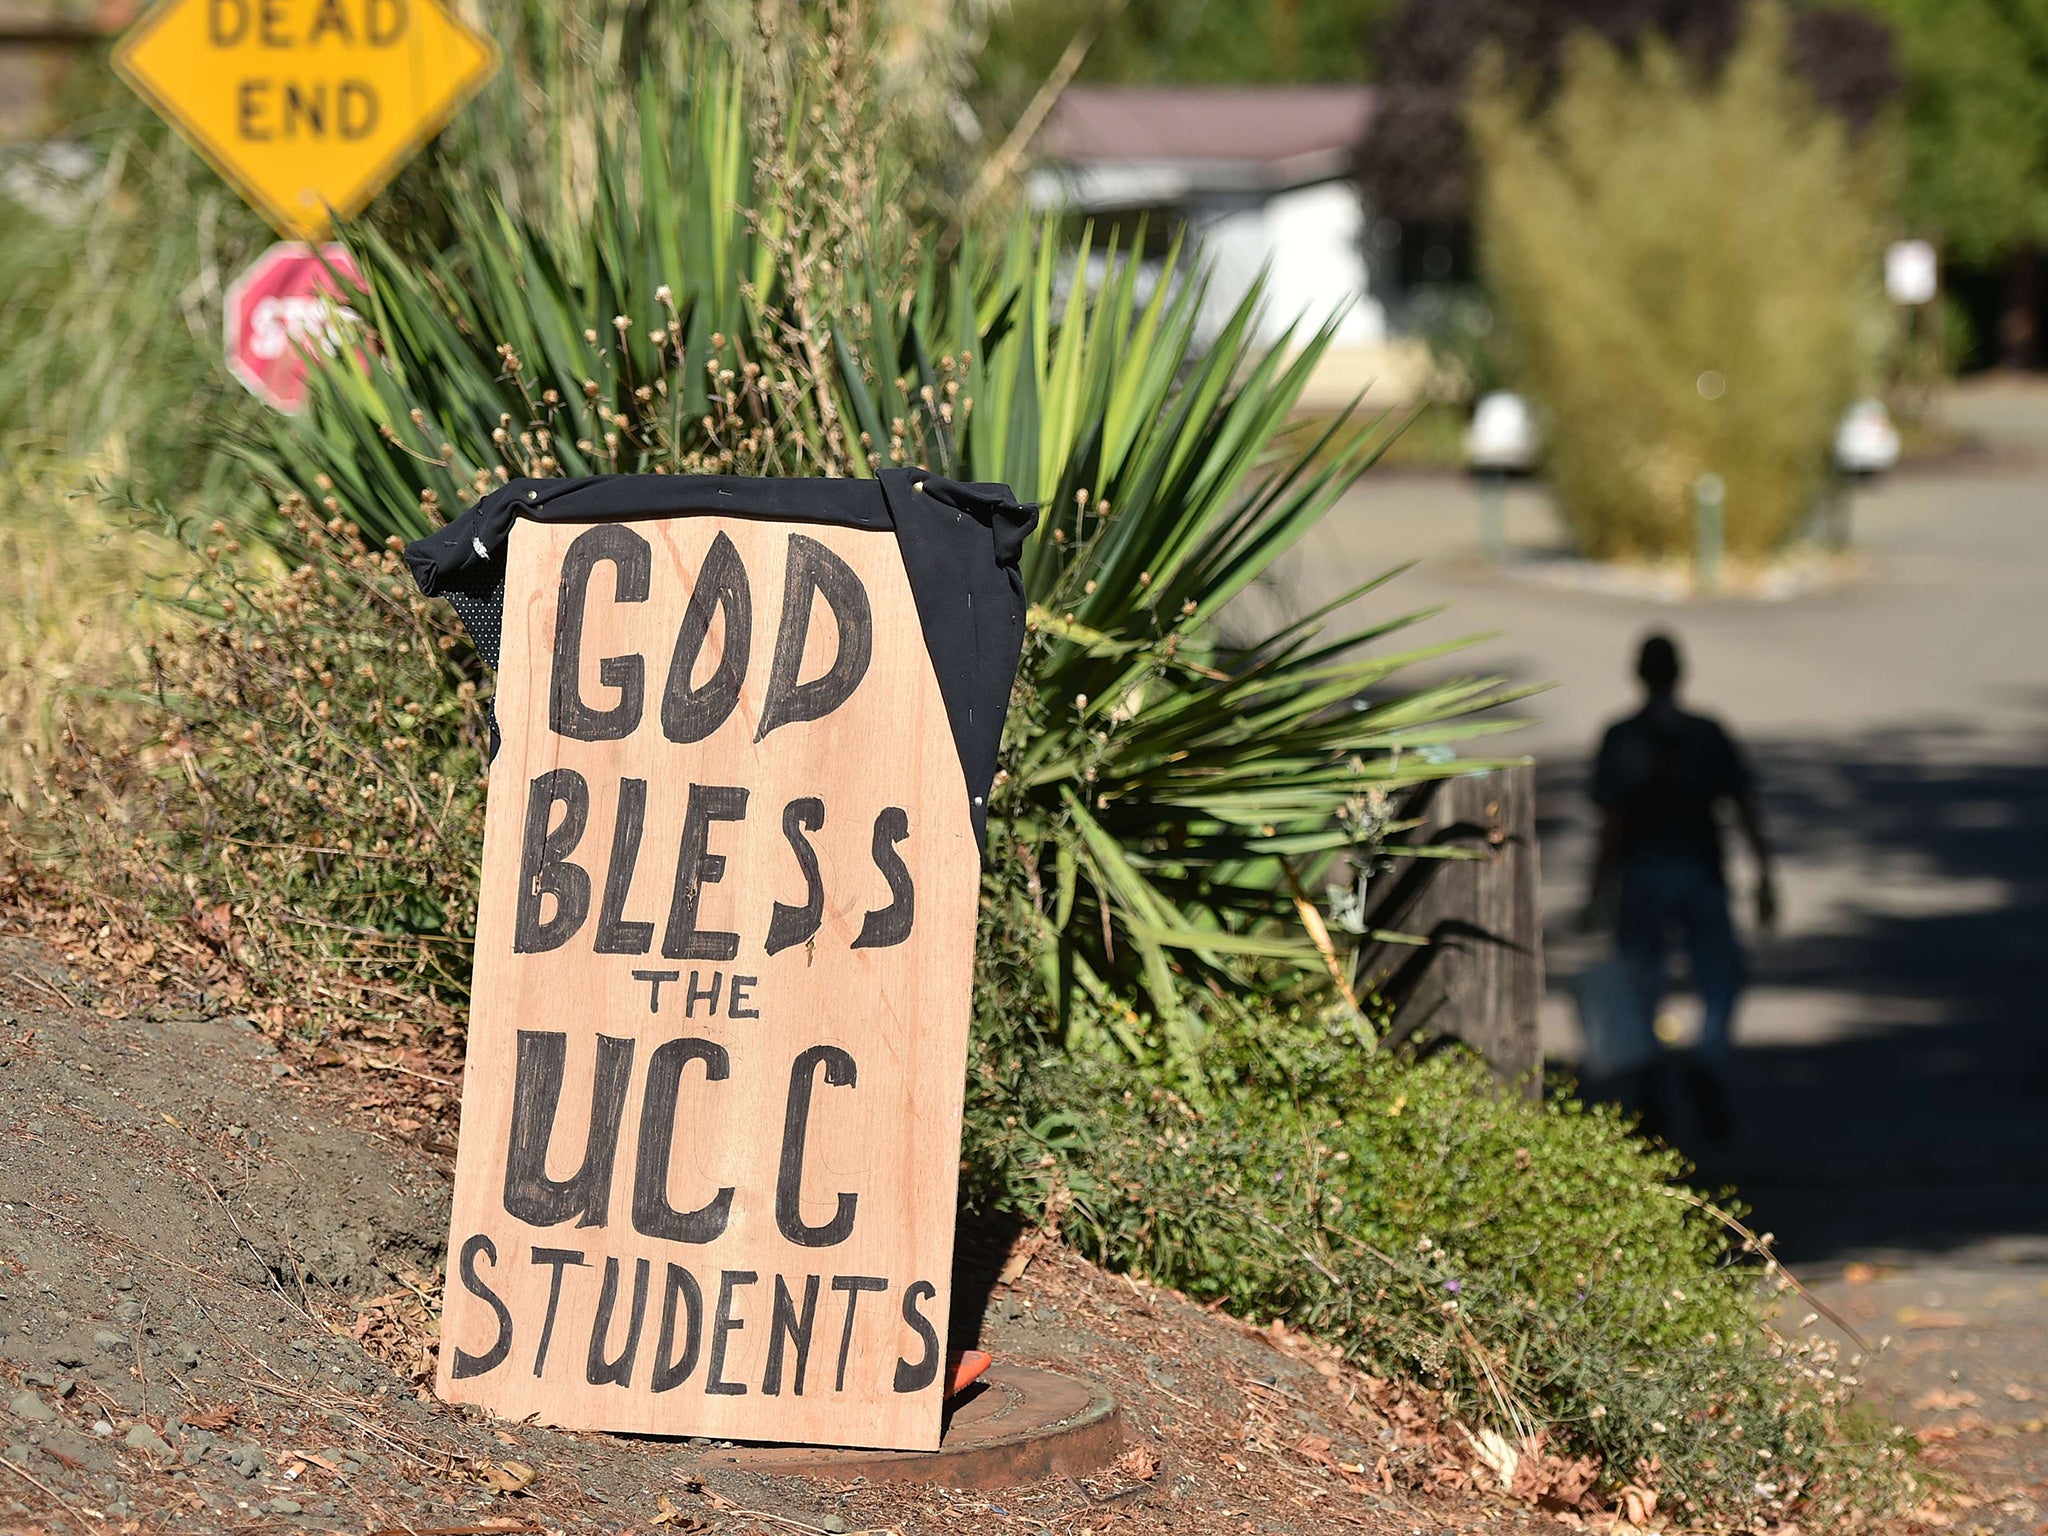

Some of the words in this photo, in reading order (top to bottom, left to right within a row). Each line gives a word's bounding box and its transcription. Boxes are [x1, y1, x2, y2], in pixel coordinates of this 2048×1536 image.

[208, 0, 410, 48] DEAD
[236, 77, 380, 142] END
[549, 523, 873, 744] GOD
[512, 768, 915, 961] BLESS
[631, 969, 761, 1019] THE
[503, 1029, 859, 1248] UCC
[451, 1233, 940, 1396] STUDENTS
